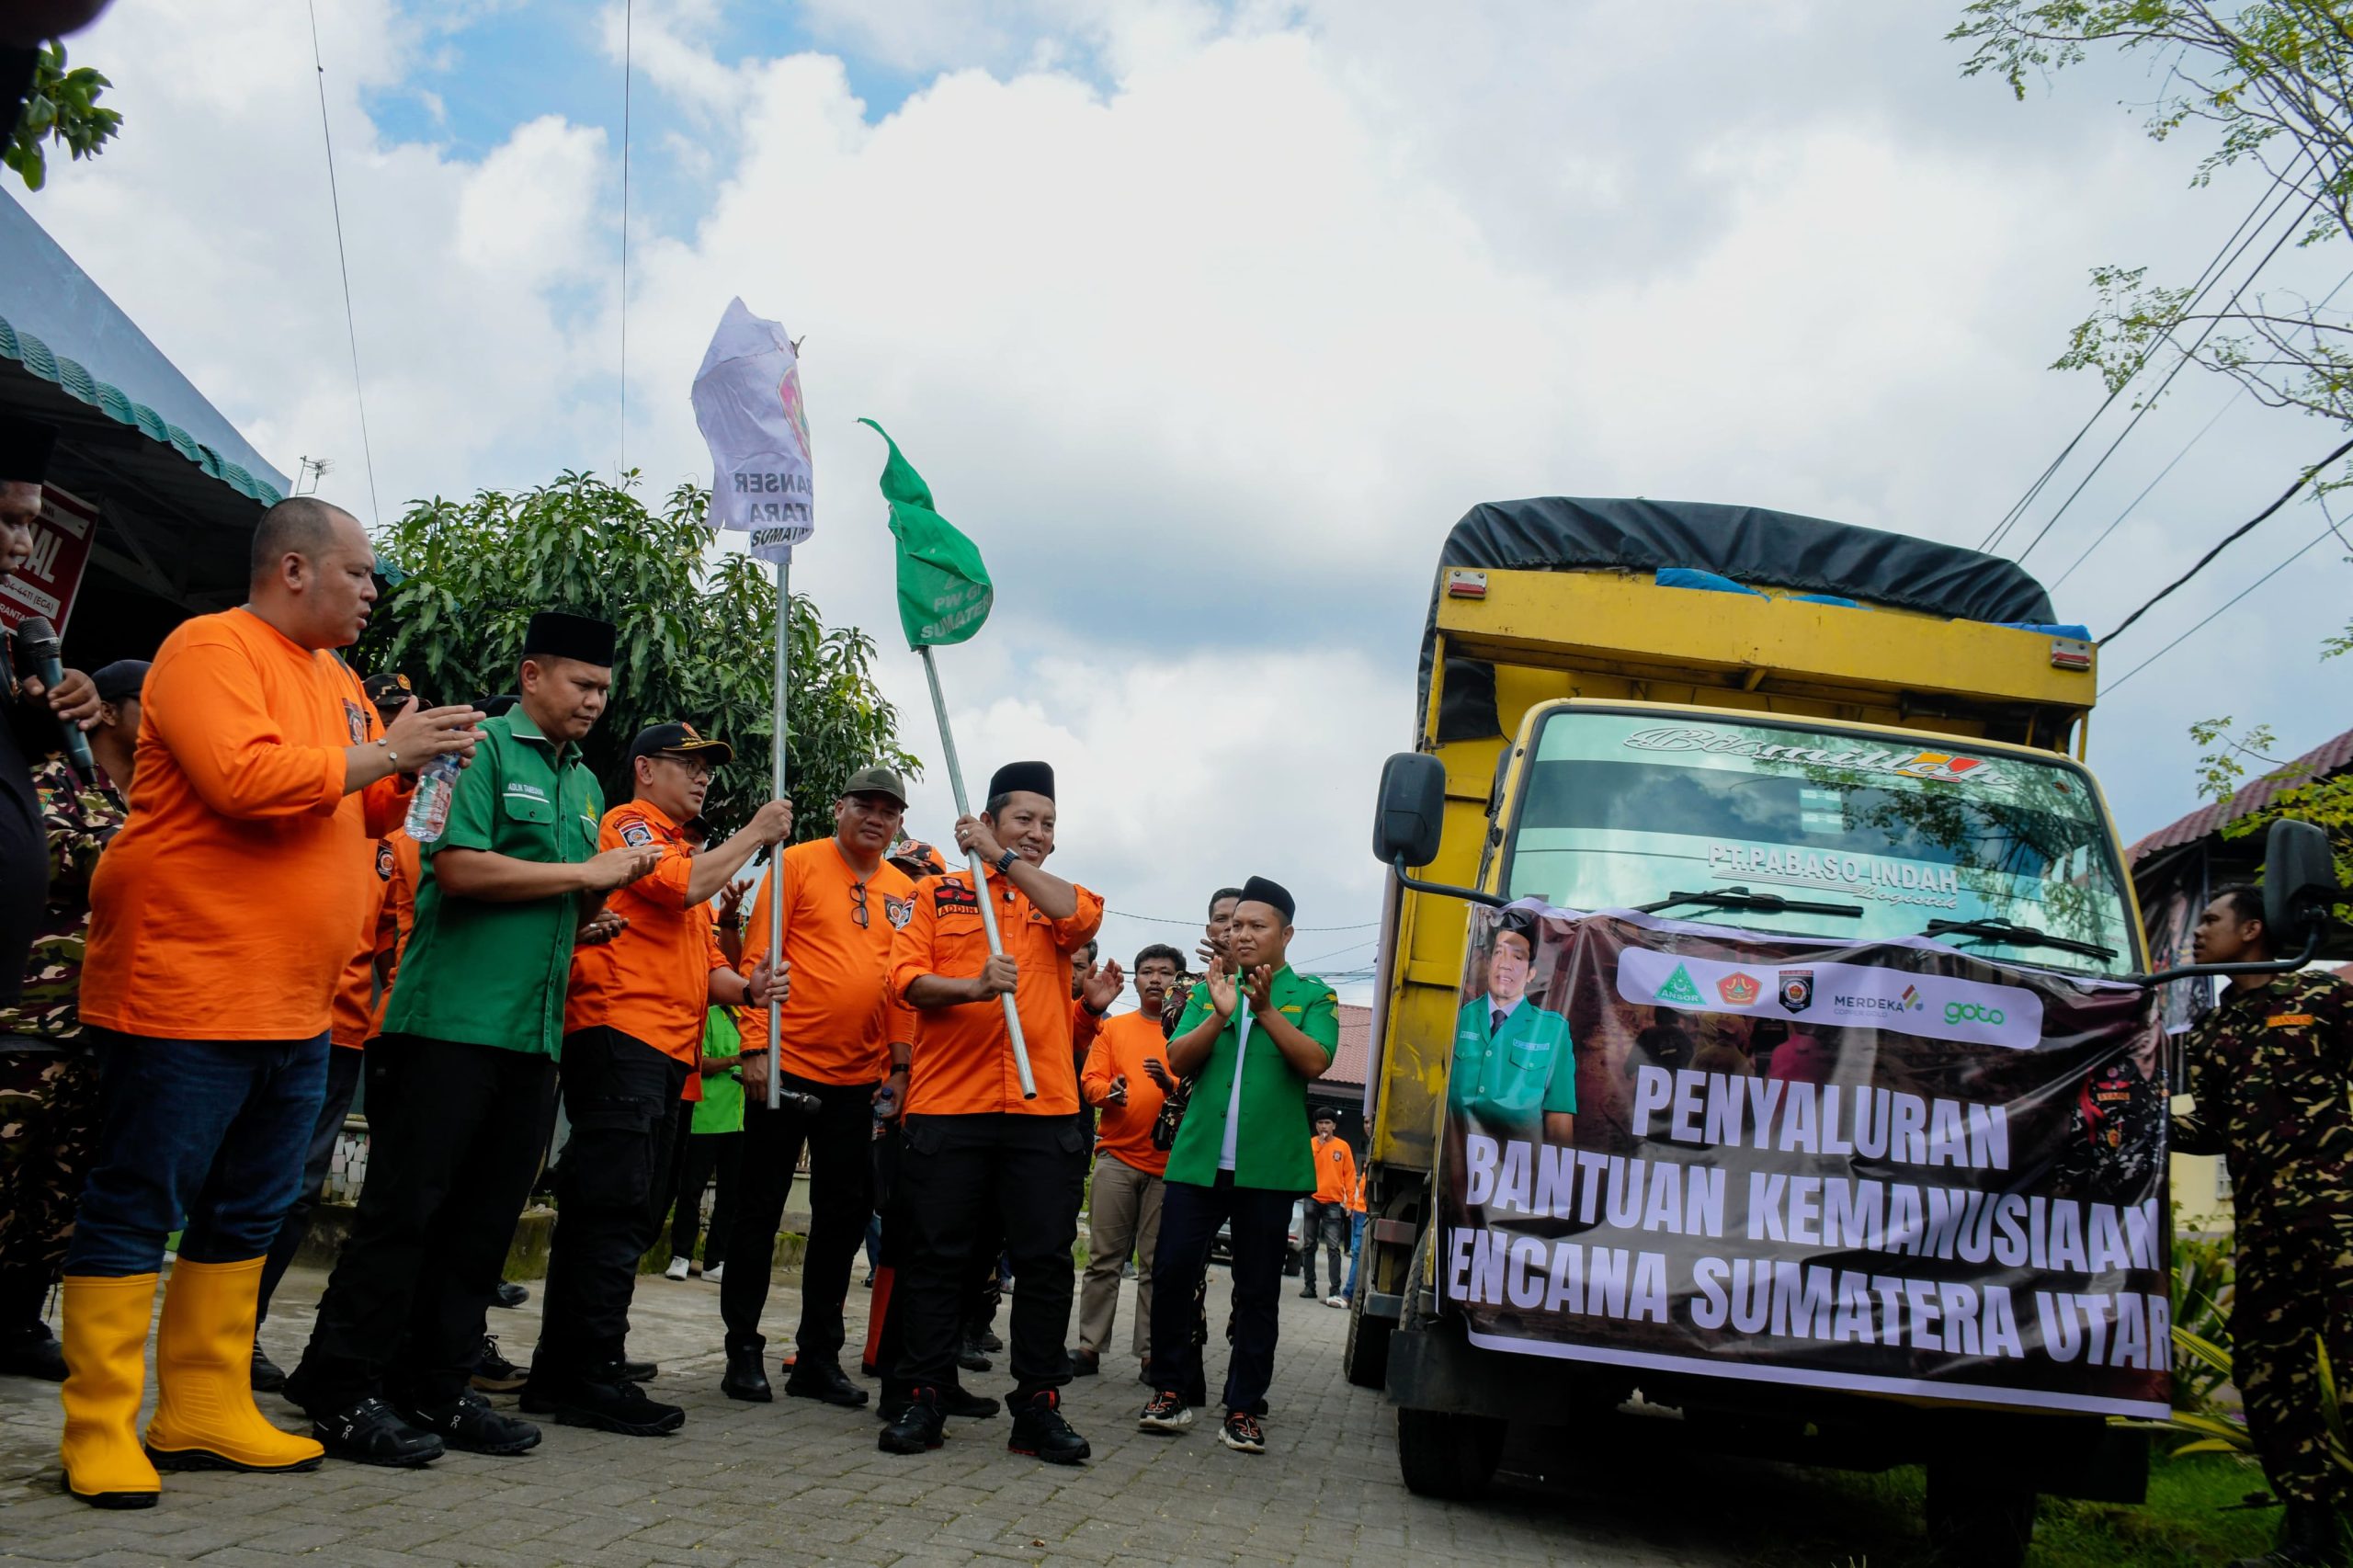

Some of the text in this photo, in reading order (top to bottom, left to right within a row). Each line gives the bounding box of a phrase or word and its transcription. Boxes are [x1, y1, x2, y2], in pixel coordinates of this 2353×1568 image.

[0, 602, 30, 622] RANTA
[934, 592, 963, 613] PW
[1622, 727, 2013, 786] Bismillah
[1870, 859, 1959, 895] INDAH
[1851, 884, 1958, 910] Logistik
[940, 905, 975, 915] ADDIN
[1661, 989, 1699, 1003] ANSOR
[1834, 995, 1905, 1013] MERDEKA
[1944, 1002, 2005, 1025] goto
[1631, 1064, 2009, 1171] PENYALURAN
[1466, 1133, 2160, 1274] BANTUAN KEMANUSIAAN
[1448, 1225, 1668, 1324] ENCANA
[1690, 1257, 2025, 1358] SUMATERA
